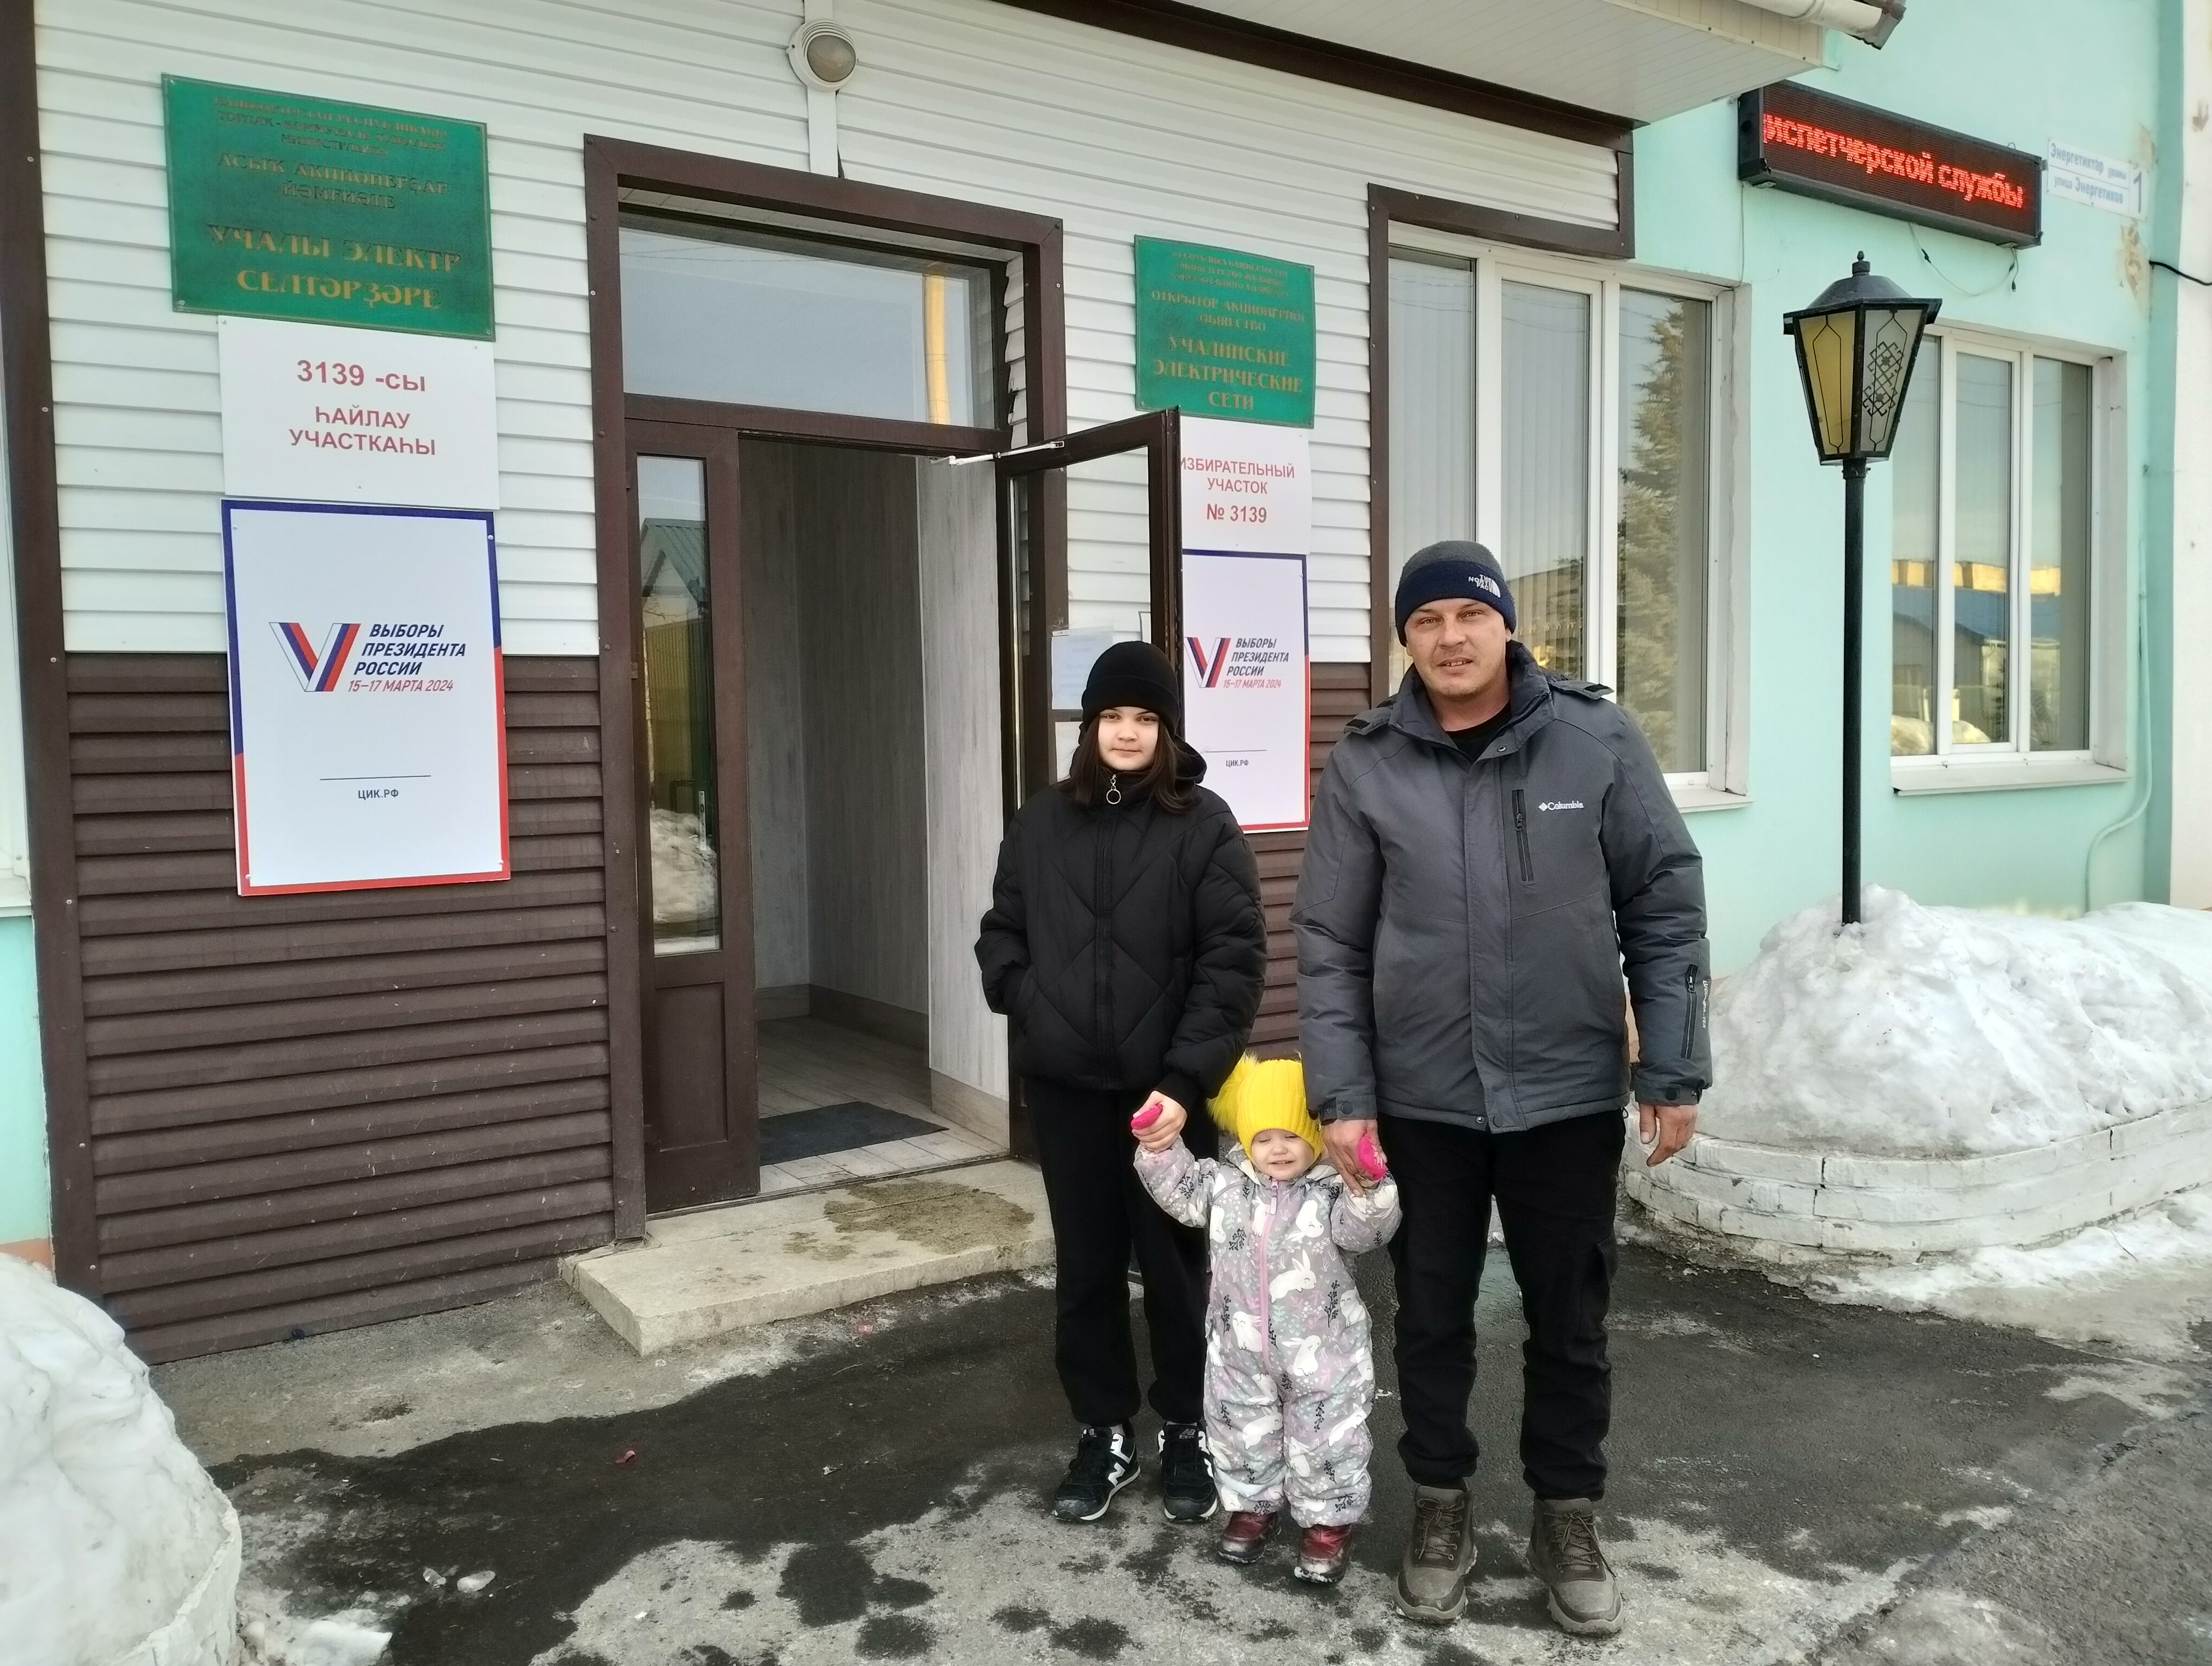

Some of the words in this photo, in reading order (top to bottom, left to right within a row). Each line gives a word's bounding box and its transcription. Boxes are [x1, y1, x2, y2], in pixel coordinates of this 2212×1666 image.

[1938, 164, 2024, 208] службы
[2054, 176, 2073, 189] улица
[2075, 176, 2124, 204] Энергетиков
[2133, 171, 2142, 214] 1
[207, 223, 331, 259] УЧАЛЫ
[343, 240, 462, 272] ЭЛЕКТР
[1168, 336, 1290, 367] УЧАЛИНСКИЕ
[297, 360, 365, 387] 3139
[1152, 359, 1303, 393] ЭЛЕКТРИЧЕСКИЕ
[1207, 391, 1254, 410] СЕТИ
[1180, 457, 1295, 479] ИЗБИРАТЕЛЬНЫЙ
[1207, 477, 1268, 495] УЧАСТОК
[1206, 503, 1225, 521] №
[1230, 505, 1268, 523] 3139
[369, 623, 445, 638] ВЫБОРЫ
[361, 643, 466, 659] ПРЕЗИДЕНТА
[1235, 638, 1278, 649] ВЫБОРЫ
[1231, 652, 1290, 664] ПРЕЗИДЕНТА
[353, 661, 423, 676] РОССИИ
[1226, 665, 1265, 676] РОССИИ
[382, 680, 423, 693] МАРТА
[425, 680, 454, 693] 2024
[1242, 679, 1264, 688] МАРТА
[1265, 679, 1282, 688] 2024
[1225, 759, 1249, 768] ЦИК.РФ
[357, 789, 399, 801] ЦИК.РФ
[1547, 800, 1585, 811] Columbia
